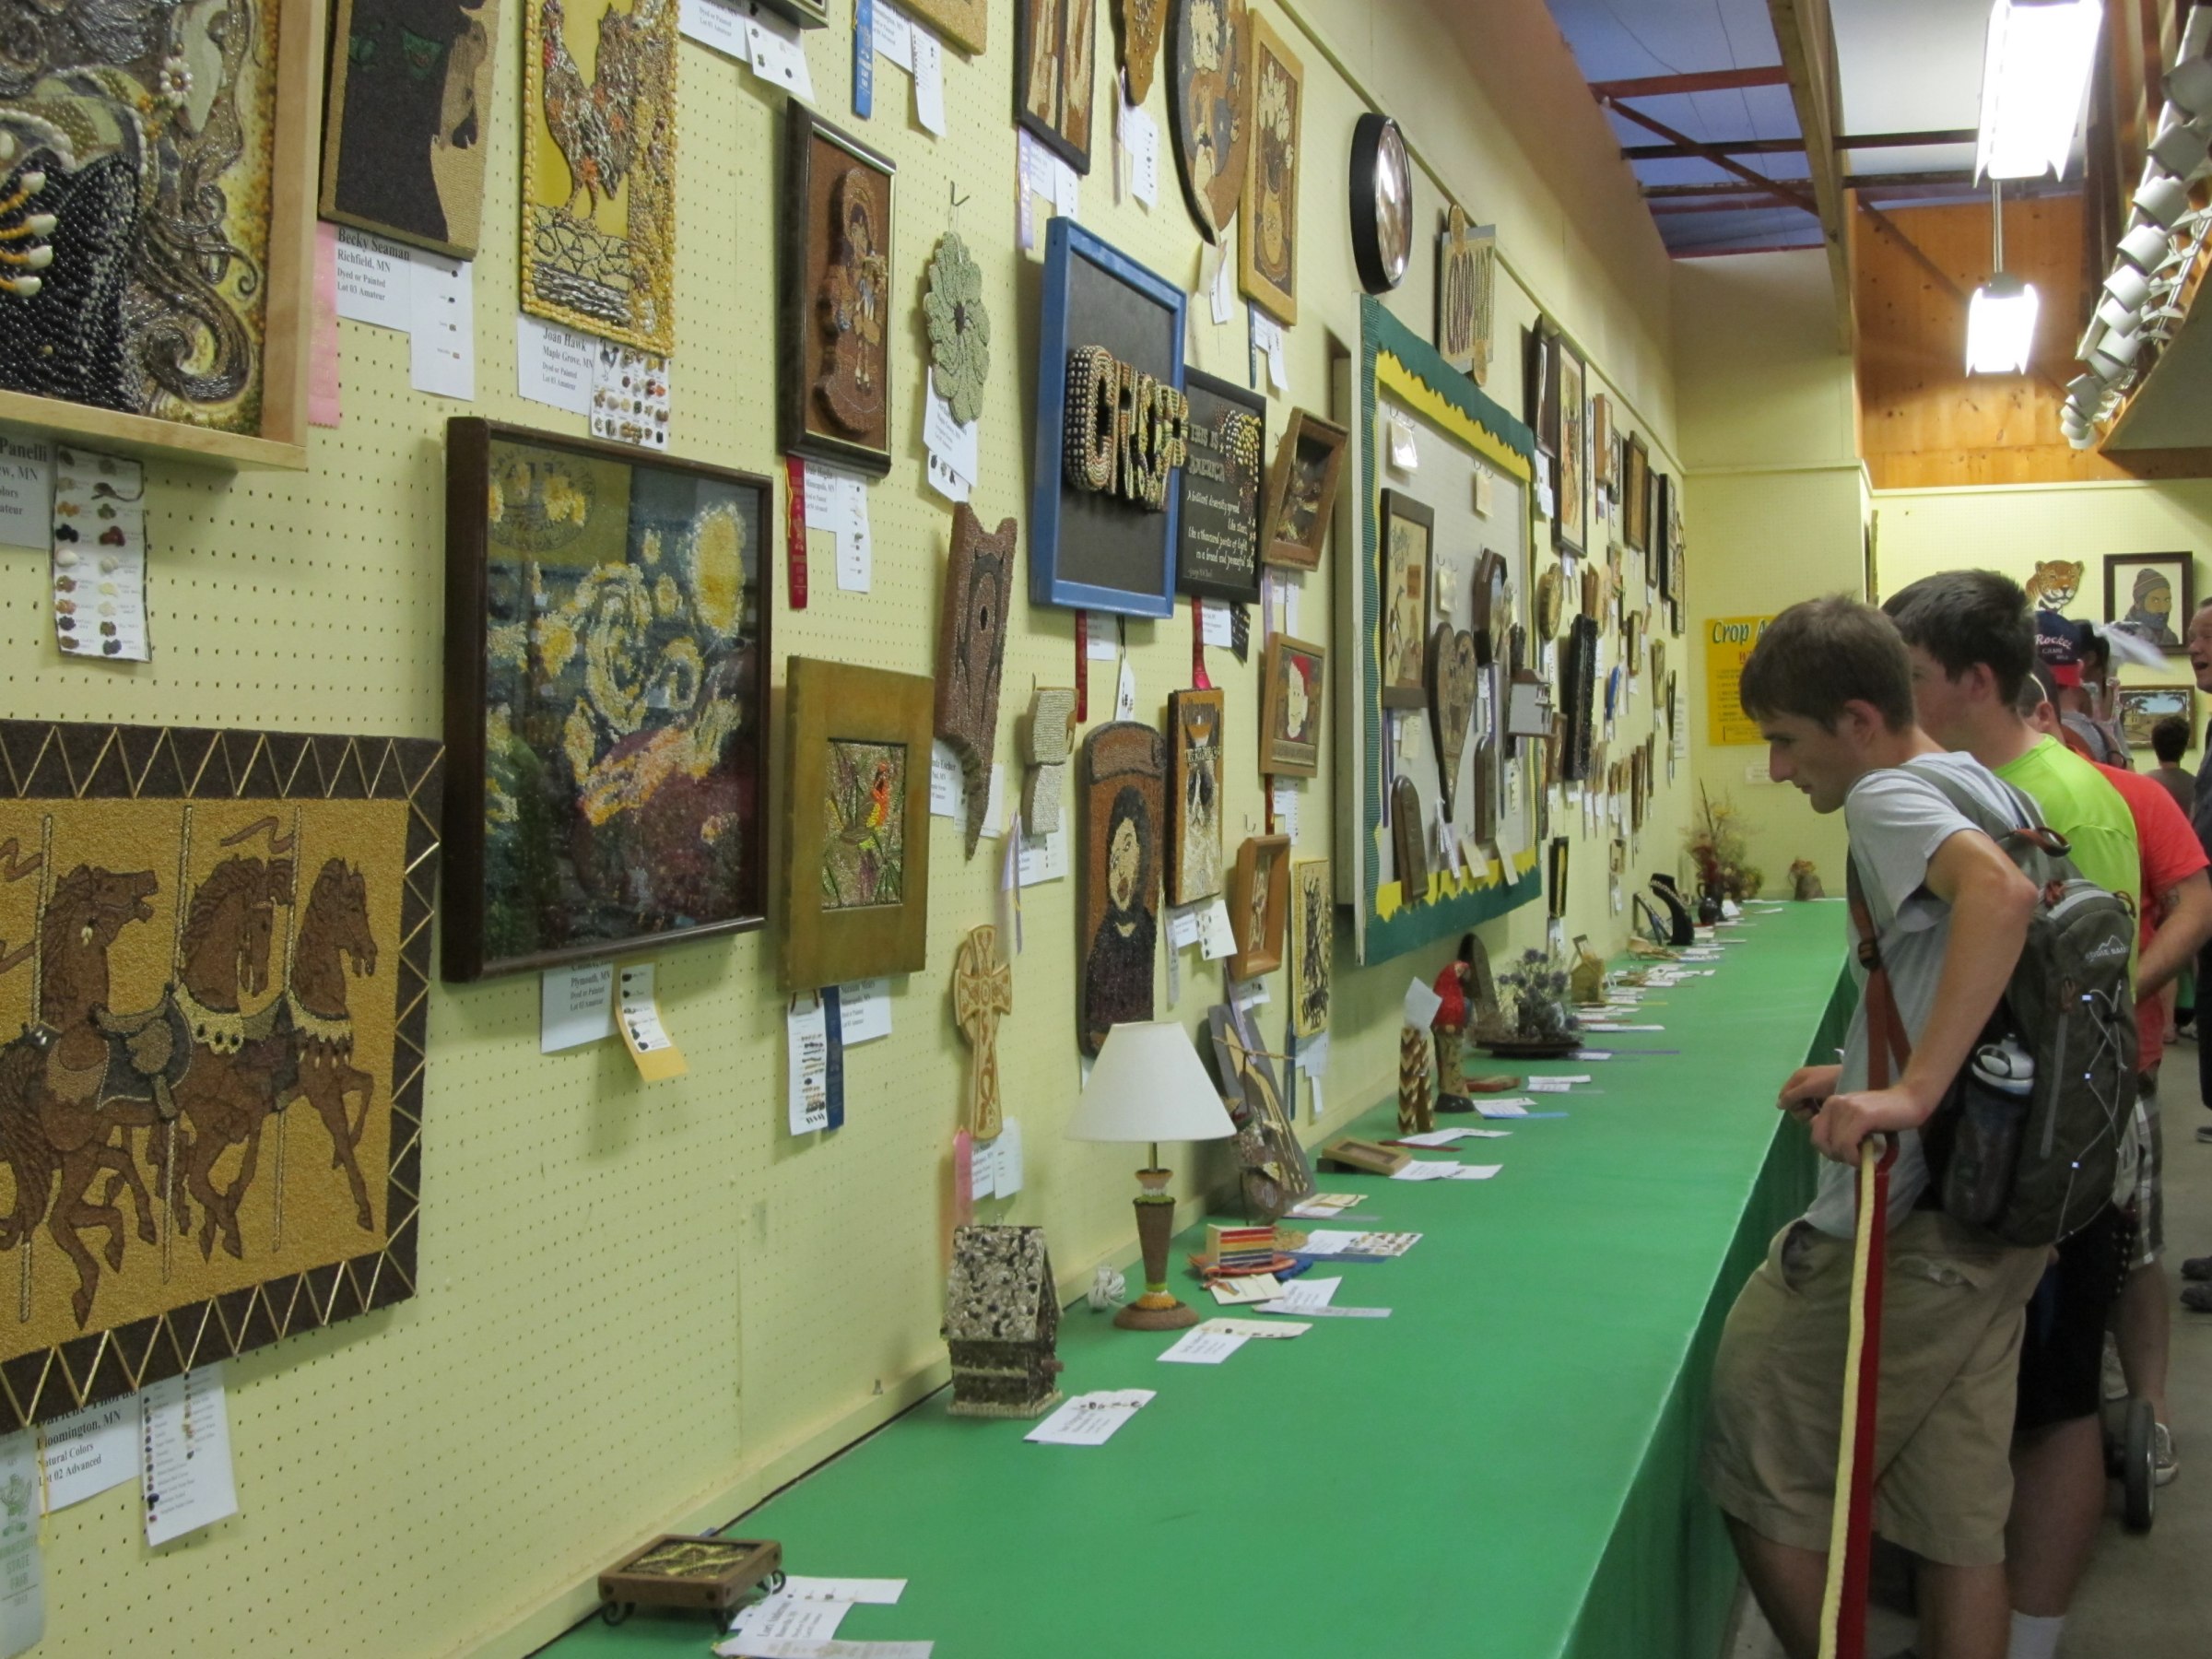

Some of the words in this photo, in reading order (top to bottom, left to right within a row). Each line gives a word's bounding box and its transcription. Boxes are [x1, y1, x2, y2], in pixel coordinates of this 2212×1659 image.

[338, 228, 369, 253] Becky
[371, 237, 410, 262] Seaman
[337, 249, 375, 269] Richfield,
[376, 260, 392, 274] MN
[337, 267, 354, 281] Dyed
[363, 274, 386, 288] Painted
[337, 282, 348, 291] Lot
[359, 288, 385, 301] Amateur
[543, 327, 562, 345] Joan
[564, 334, 587, 353] Hawk
[543, 346, 561, 362] Maple
[562, 351, 582, 367] Grove,
[582, 358, 594, 369] MN
[0, 437, 48, 462] Panelli
[18, 465, 38, 481] MN
[1712, 621, 1750, 645] Crop
[600, 970, 611, 981] MN
[103, 1408, 122, 1425] MN
[69, 1441, 94, 1459] Colors
[53, 1469, 64, 1480] 02
[65, 1453, 101, 1477] Advanced
